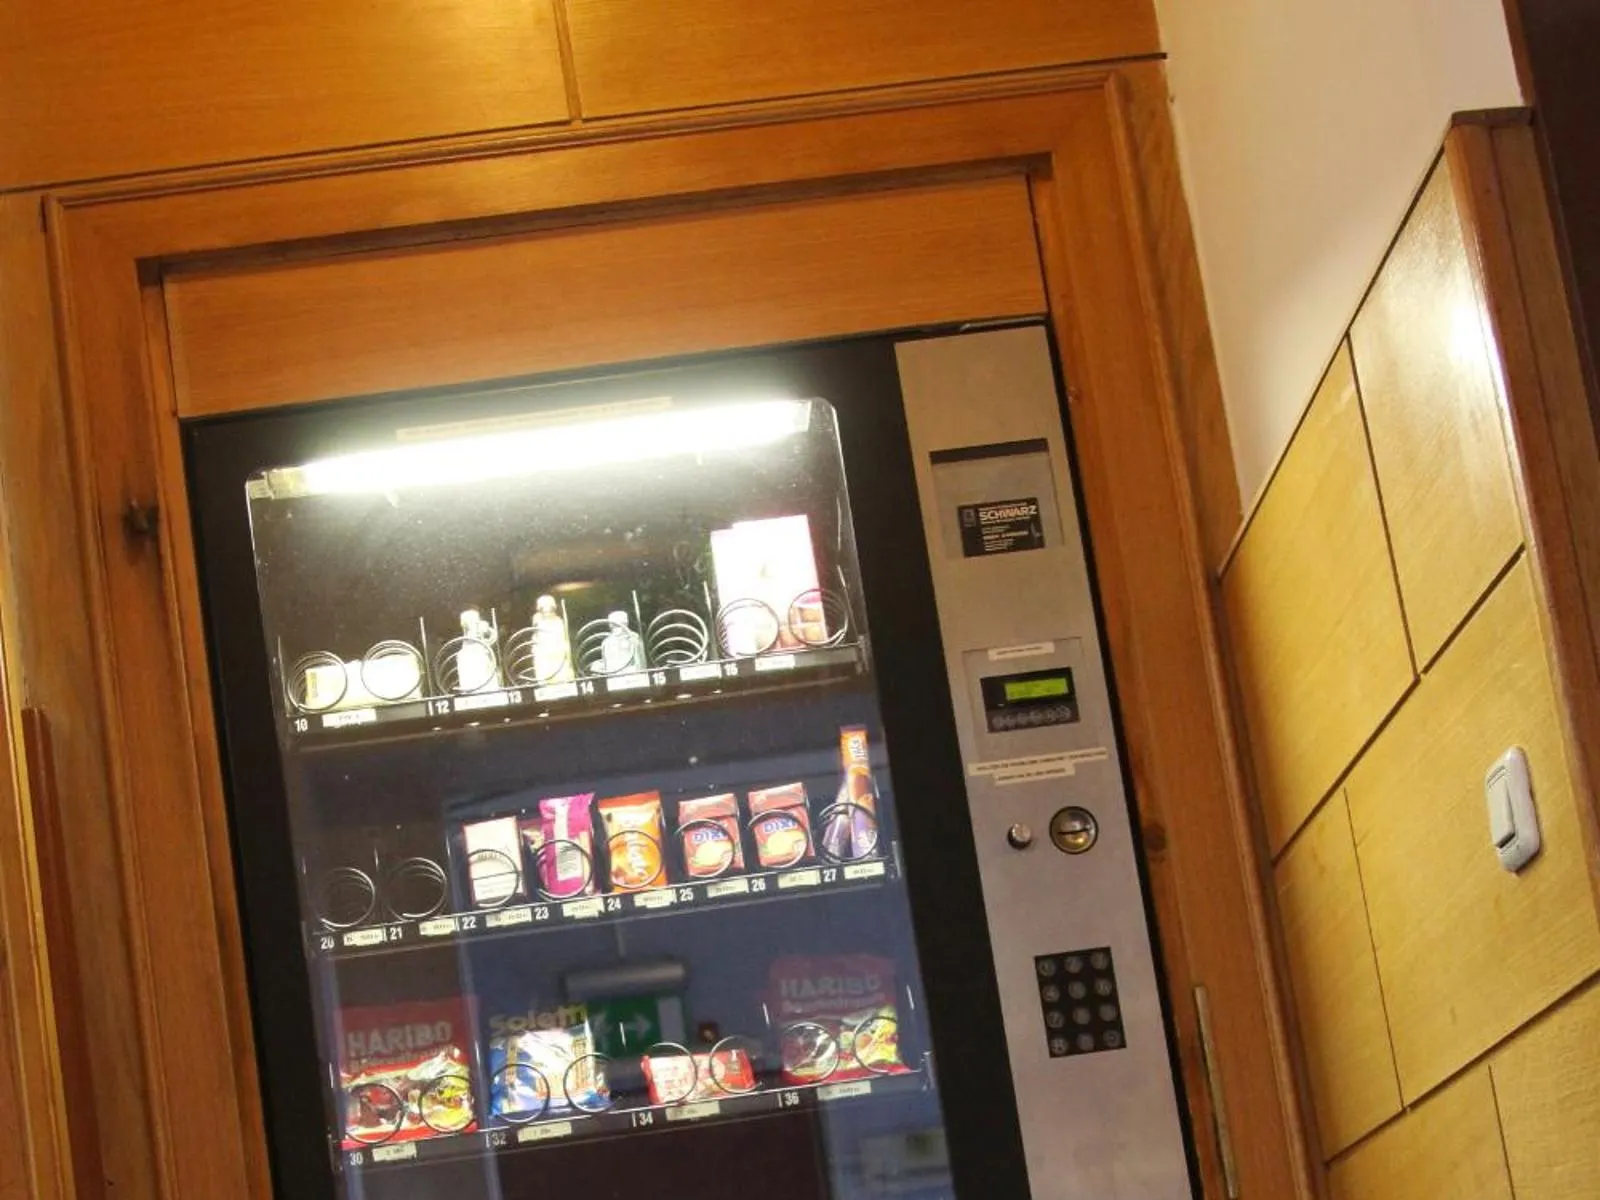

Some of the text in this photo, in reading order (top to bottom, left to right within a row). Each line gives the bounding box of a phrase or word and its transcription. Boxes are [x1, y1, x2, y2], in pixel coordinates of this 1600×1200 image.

[979, 505, 1038, 521] SCHWARZ
[653, 672, 667, 686] 15
[581, 681, 594, 695] 14
[508, 690, 522, 703] 13
[435, 700, 449, 714] 12
[294, 719, 308, 732] 10
[823, 868, 837, 882] 27
[751, 878, 766, 892] 26
[680, 888, 694, 902] 25
[607, 898, 621, 911] 24
[534, 907, 549, 920] 23
[462, 916, 477, 930] 22
[389, 926, 403, 940] 21
[321, 936, 335, 950] 20
[780, 973, 881, 1000] HARIBO
[347, 1020, 453, 1057] HARIBO
[785, 1091, 799, 1106] 36
[638, 1111, 653, 1126] 34
[492, 1133, 507, 1146] 32
[349, 1152, 364, 1166] 30
